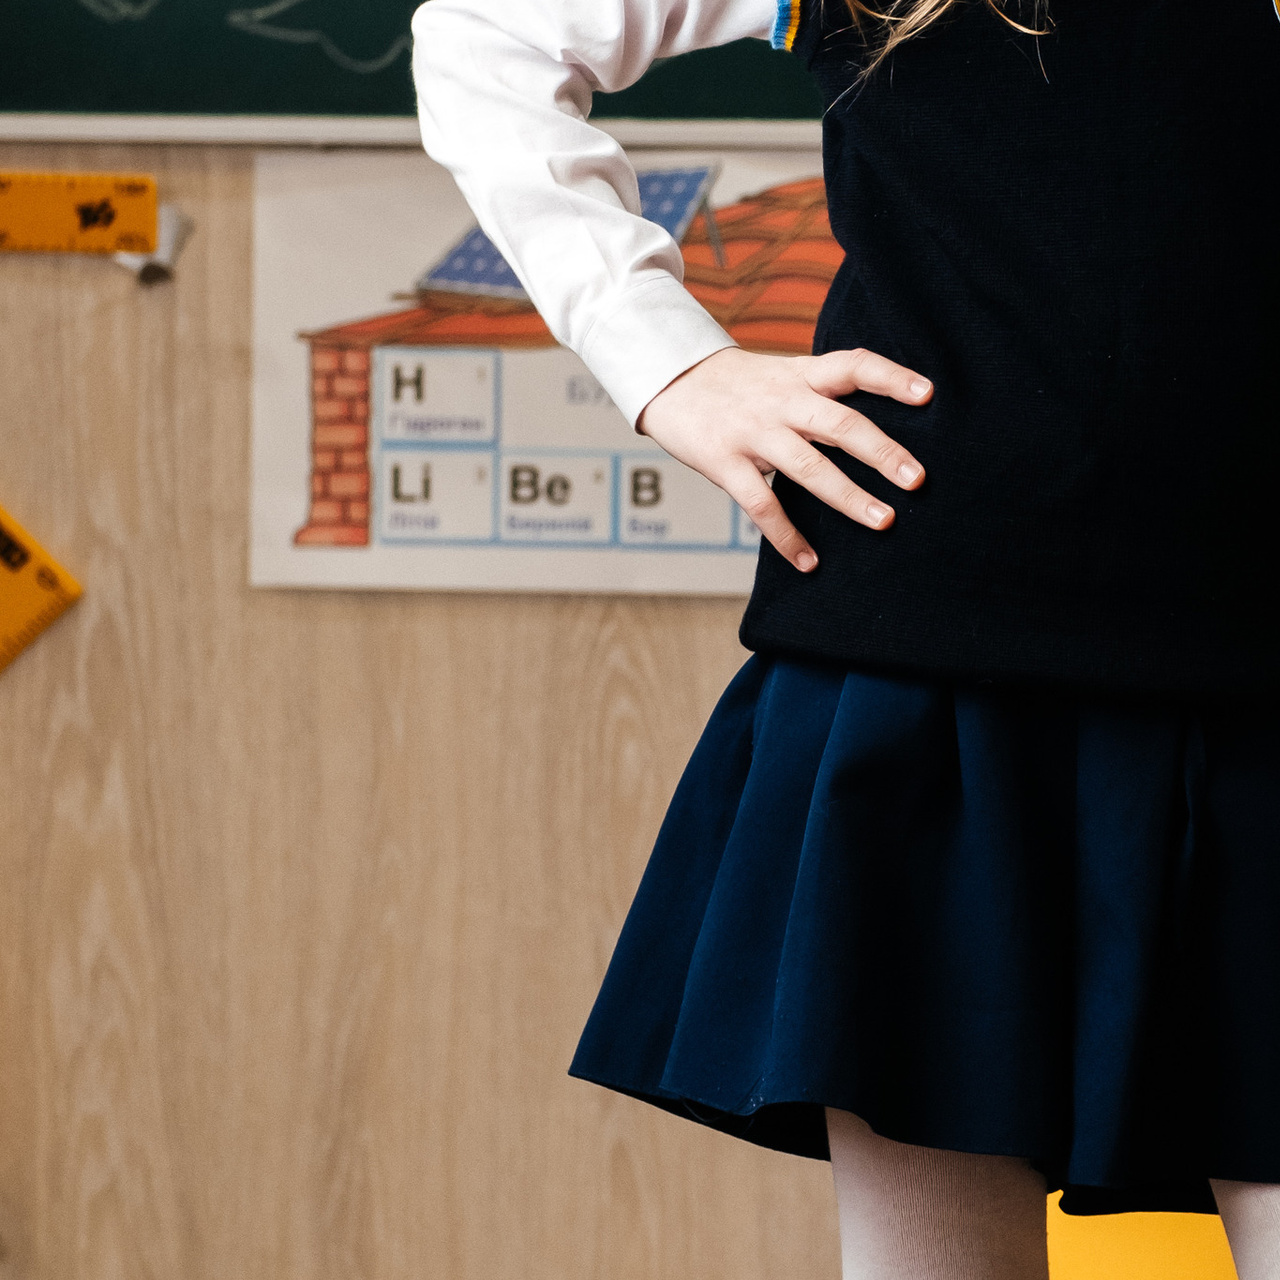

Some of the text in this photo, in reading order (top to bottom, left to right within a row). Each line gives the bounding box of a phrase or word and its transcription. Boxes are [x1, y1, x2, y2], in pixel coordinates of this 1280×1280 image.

[392, 364, 425, 403] H
[509, 465, 573, 507] Be
[631, 467, 663, 508] B
